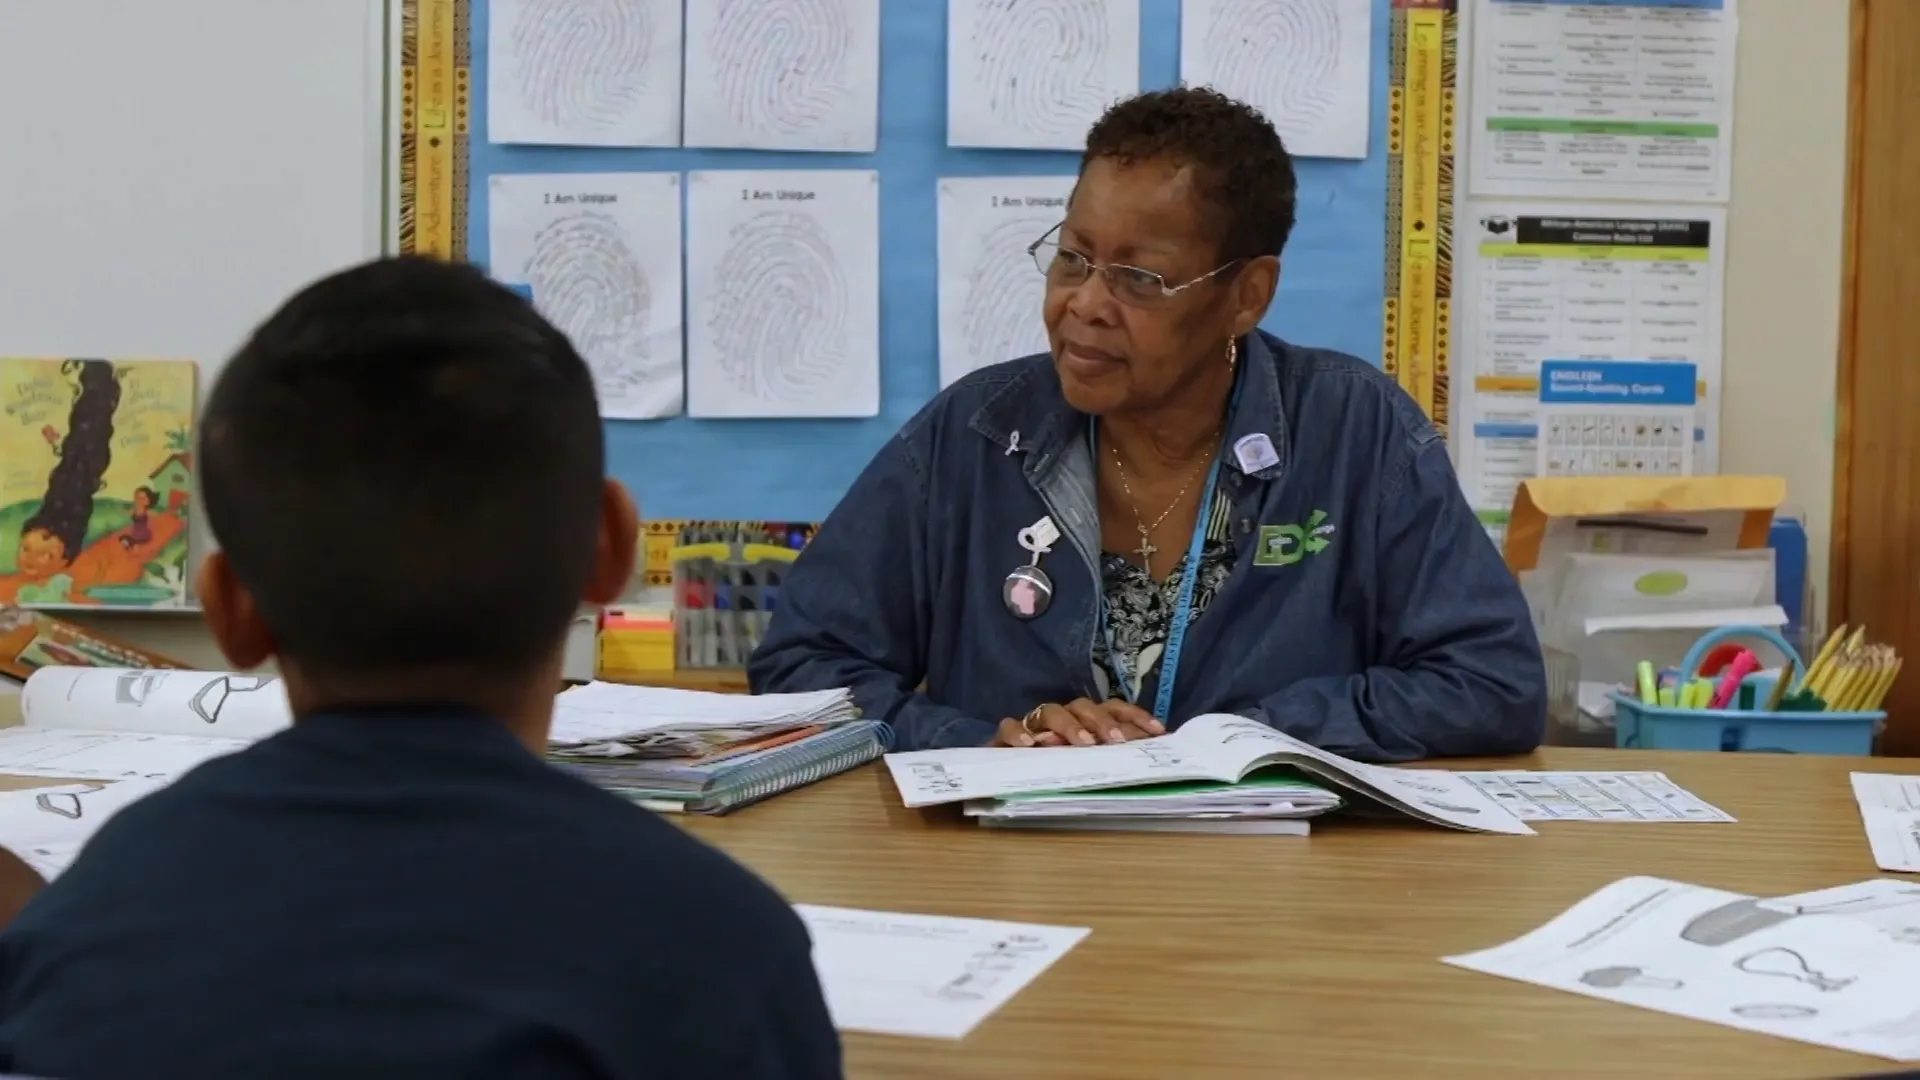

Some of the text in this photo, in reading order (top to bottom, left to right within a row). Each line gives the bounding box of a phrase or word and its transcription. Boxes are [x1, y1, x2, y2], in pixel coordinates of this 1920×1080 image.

[544, 192, 618, 205] I Am Unique
[742, 189, 816, 202] I Am Unique
[1001, 195, 1023, 207] Am
